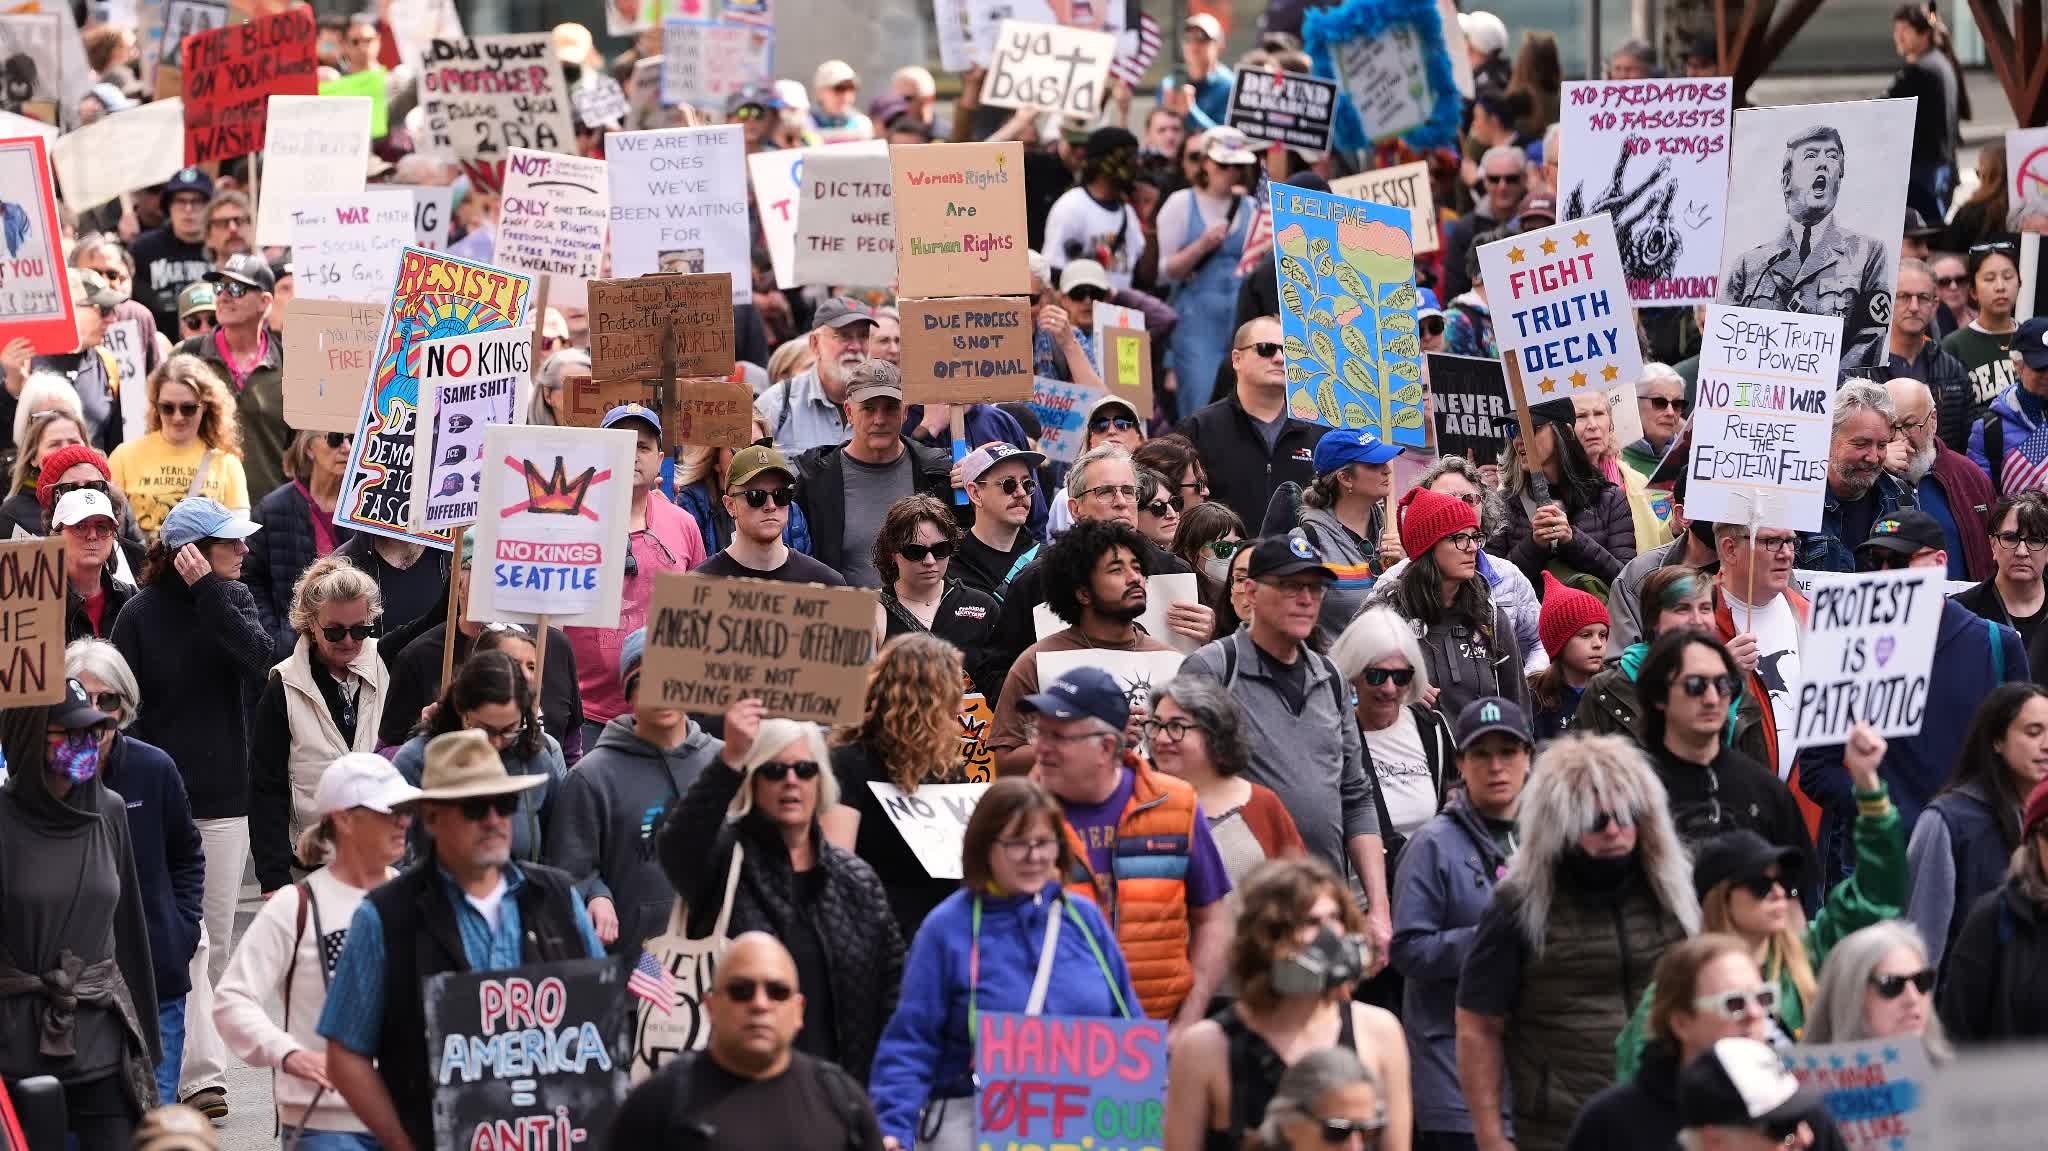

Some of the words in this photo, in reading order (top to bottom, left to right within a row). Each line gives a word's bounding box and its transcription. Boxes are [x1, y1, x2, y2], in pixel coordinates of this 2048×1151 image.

[189, 31, 230, 70] THE
[241, 15, 312, 56] BLOOD
[432, 38, 479, 60] Did
[485, 42, 546, 72] your
[1012, 31, 1051, 62] ya
[191, 70, 216, 98] ON
[226, 53, 271, 88] YOUR
[441, 65, 551, 95] MOTHER
[991, 47, 1095, 113] basta
[513, 96, 558, 113] you
[1570, 86, 1601, 106] NO
[1602, 82, 1727, 106] PREDATORS
[1590, 112, 1617, 131] NO
[1620, 107, 1726, 131] FASCISTS
[616, 136, 648, 152] WE
[653, 136, 688, 150] ARE
[695, 132, 729, 145] THE
[1625, 138, 1651, 157] NO
[1657, 134, 1725, 163] KINGS
[650, 156, 704, 172] ONES
[648, 180, 710, 196] WE'VE
[336, 207, 369, 225] WAR
[504, 197, 549, 217] ONLY
[610, 206, 660, 221] BEEN
[665, 202, 744, 219] WAITING
[945, 202, 977, 217] Are
[1275, 191, 1285, 212] I
[1290, 195, 1368, 227] BELIEVE
[660, 228, 700, 241] FOR
[808, 236, 843, 252] THE
[910, 237, 961, 256] Human
[963, 232, 1013, 262] Rights
[9, 258, 43, 278] YOU
[520, 256, 576, 275] WEALTHY
[1509, 252, 1595, 300] FIGHT
[398, 251, 528, 320] RESIST!
[1655, 276, 1718, 299] DEMOCRACY
[924, 313, 960, 330] DUE
[964, 311, 1019, 329] PROCESS
[1512, 289, 1611, 338] TRUTH
[953, 336, 965, 350] IS
[967, 334, 1004, 349] NOT
[1715, 313, 1778, 348] SPEAK
[1780, 322, 1834, 355] TRUTH
[328, 349, 365, 370] FIRE
[427, 344, 471, 378] NO
[478, 341, 531, 375] KINGS
[1523, 327, 1619, 373] DECAY
[1723, 346, 1747, 364] TO
[1758, 348, 1820, 374] POWER
[933, 360, 1027, 378] OPTIONAL
[443, 384, 477, 404] SAME
[479, 377, 509, 399] SHIT
[1699, 379, 1729, 408] NO
[1734, 382, 1785, 410] IRAN
[1790, 387, 1826, 415] WAR
[1433, 393, 1504, 417] NEVER
[1724, 415, 1796, 442] RELEASE
[447, 448, 459, 459] ICE
[1753, 437, 1775, 453] THE
[1693, 445, 1777, 481] EPSTEIN
[1777, 450, 1829, 485] FILES
[427, 501, 478, 521] DIFFERENT
[501, 542, 529, 560] NO
[532, 543, 599, 562] KINGS
[495, 564, 597, 593] SEATTLE
[693, 586, 712, 605] IF
[728, 587, 786, 614] YOU'RE
[793, 599, 830, 617] NOT
[1811, 579, 1924, 632] PROTEST
[652, 608, 713, 652] ANGRY,
[705, 660, 754, 684] YOU'RE
[765, 667, 800, 685] NOT
[662, 679, 731, 706] PAYING
[1794, 675, 1926, 738] PATRIOTIC
[885, 796, 936, 820] NO
[480, 977, 566, 1036] PRO
[439, 1022, 612, 1086] AMERICA
[981, 1017, 1161, 1083] HANDS
[1093, 1097, 1163, 1141] OUR
